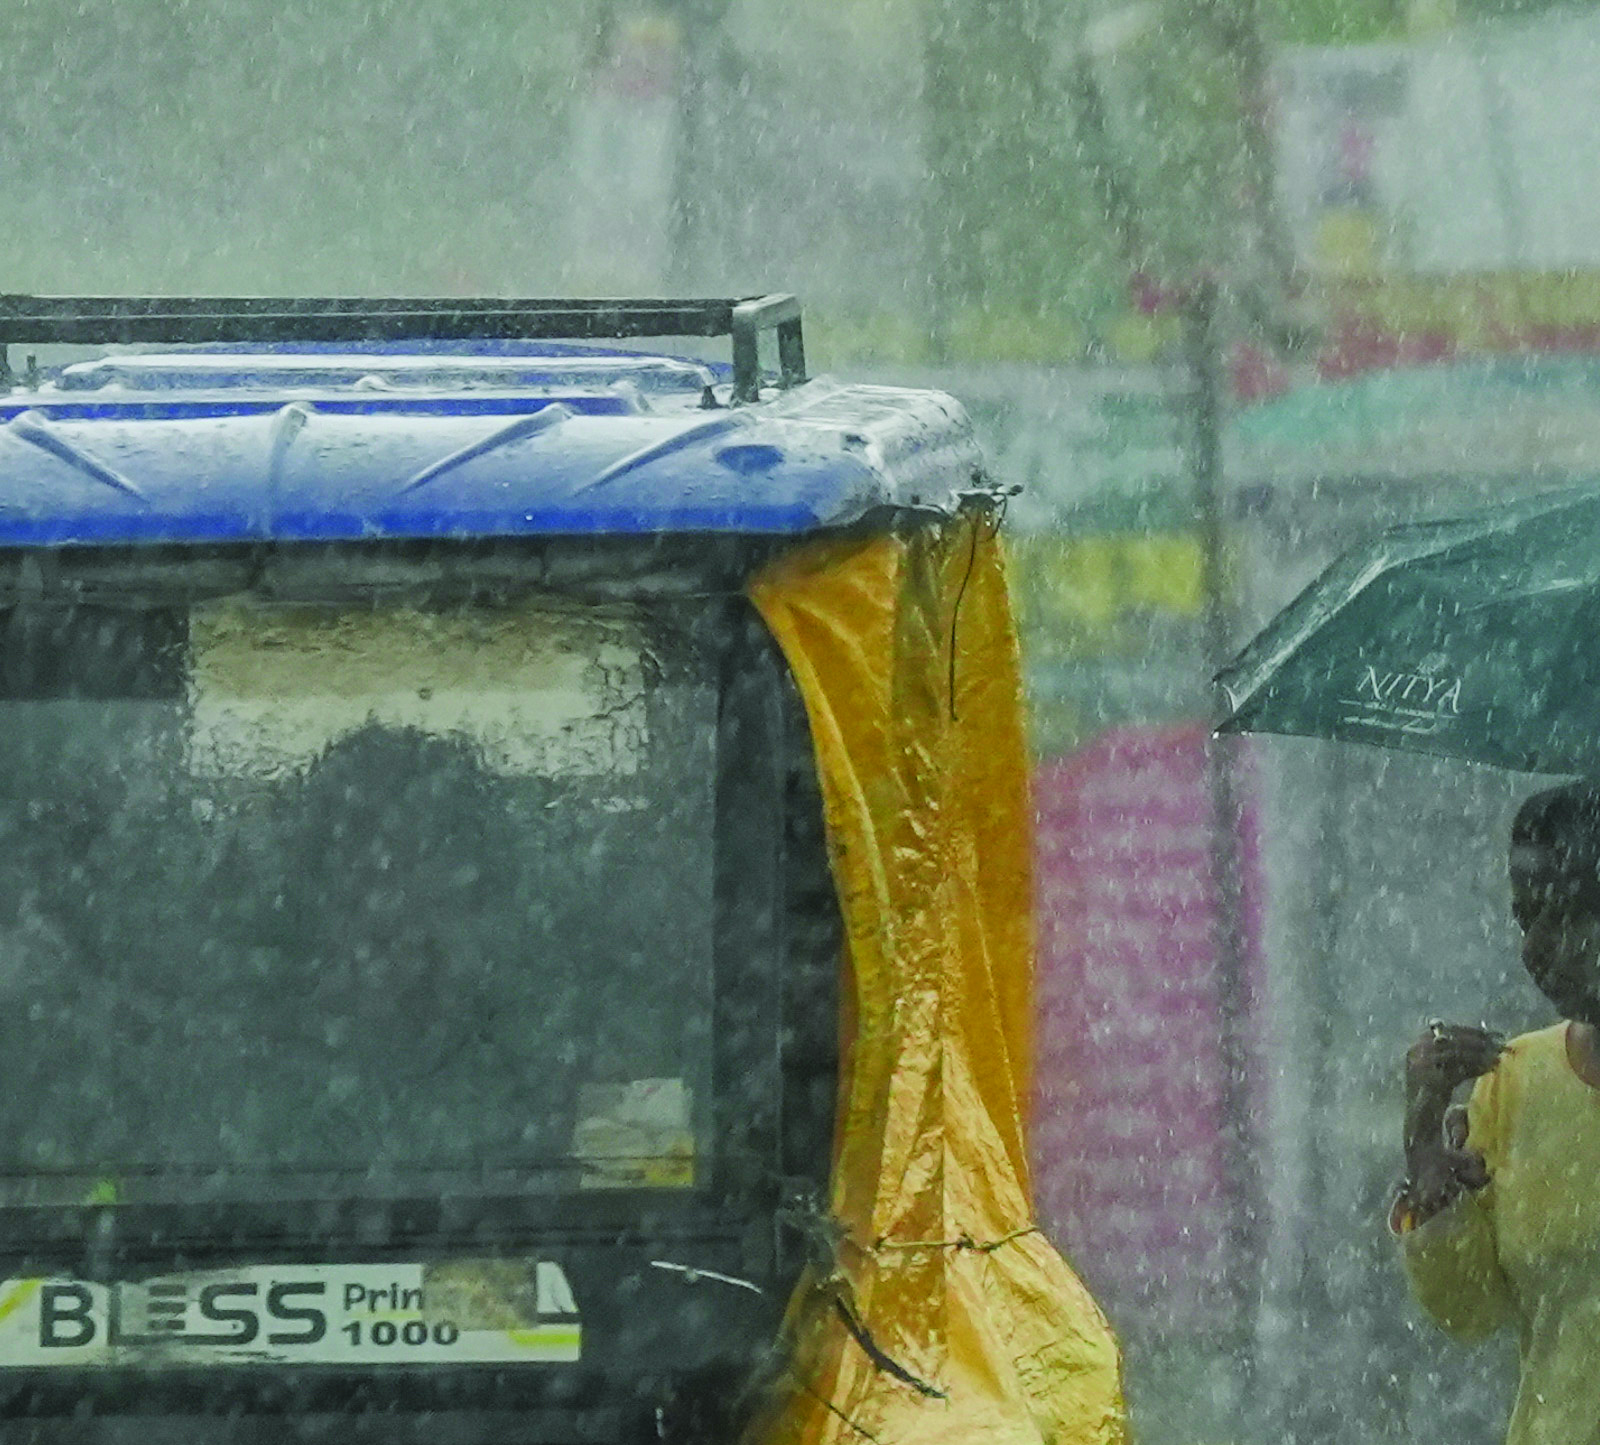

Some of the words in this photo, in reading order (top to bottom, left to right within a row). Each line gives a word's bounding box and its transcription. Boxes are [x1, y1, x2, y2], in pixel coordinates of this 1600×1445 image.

[1356, 664, 1462, 715] NITYA
[39, 1281, 327, 1348] BLESS
[341, 1319, 460, 1347] 1000
